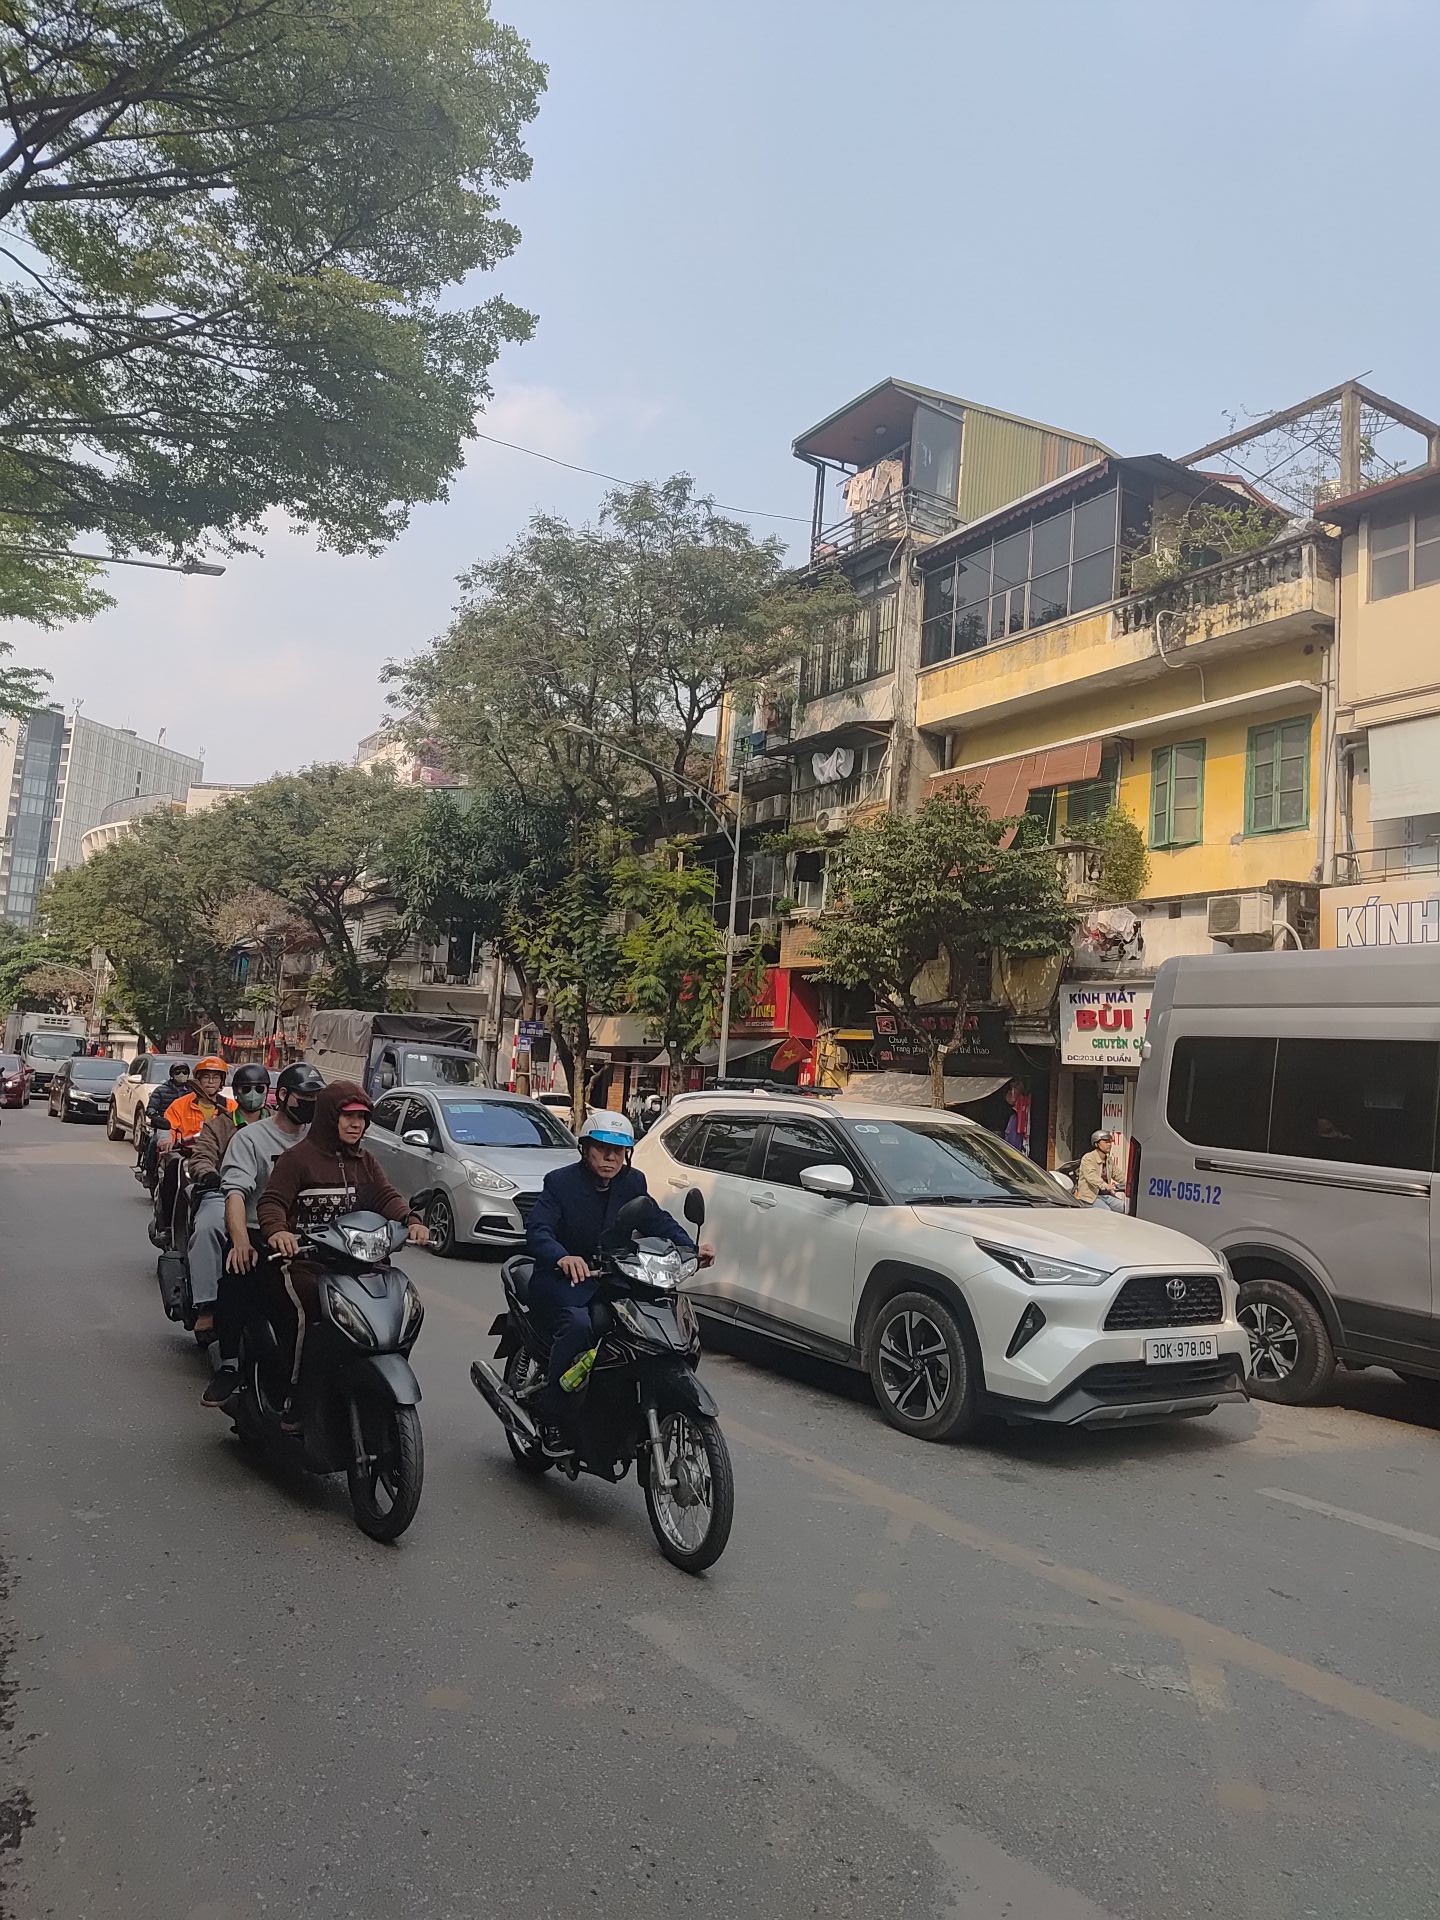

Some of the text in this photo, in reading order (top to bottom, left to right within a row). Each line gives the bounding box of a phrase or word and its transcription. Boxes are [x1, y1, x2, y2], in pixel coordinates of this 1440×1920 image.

[1337, 896, 1439, 948] KÍNH
[1069, 985, 1136, 1004] KÍNH MẮT
[1076, 1004, 1133, 1031] BÙI
[1103, 1100, 1123, 1118] KÍNH
[1148, 1177, 1222, 1205] 29K-055.12
[1152, 1340, 1212, 1359] 30K-978.09
